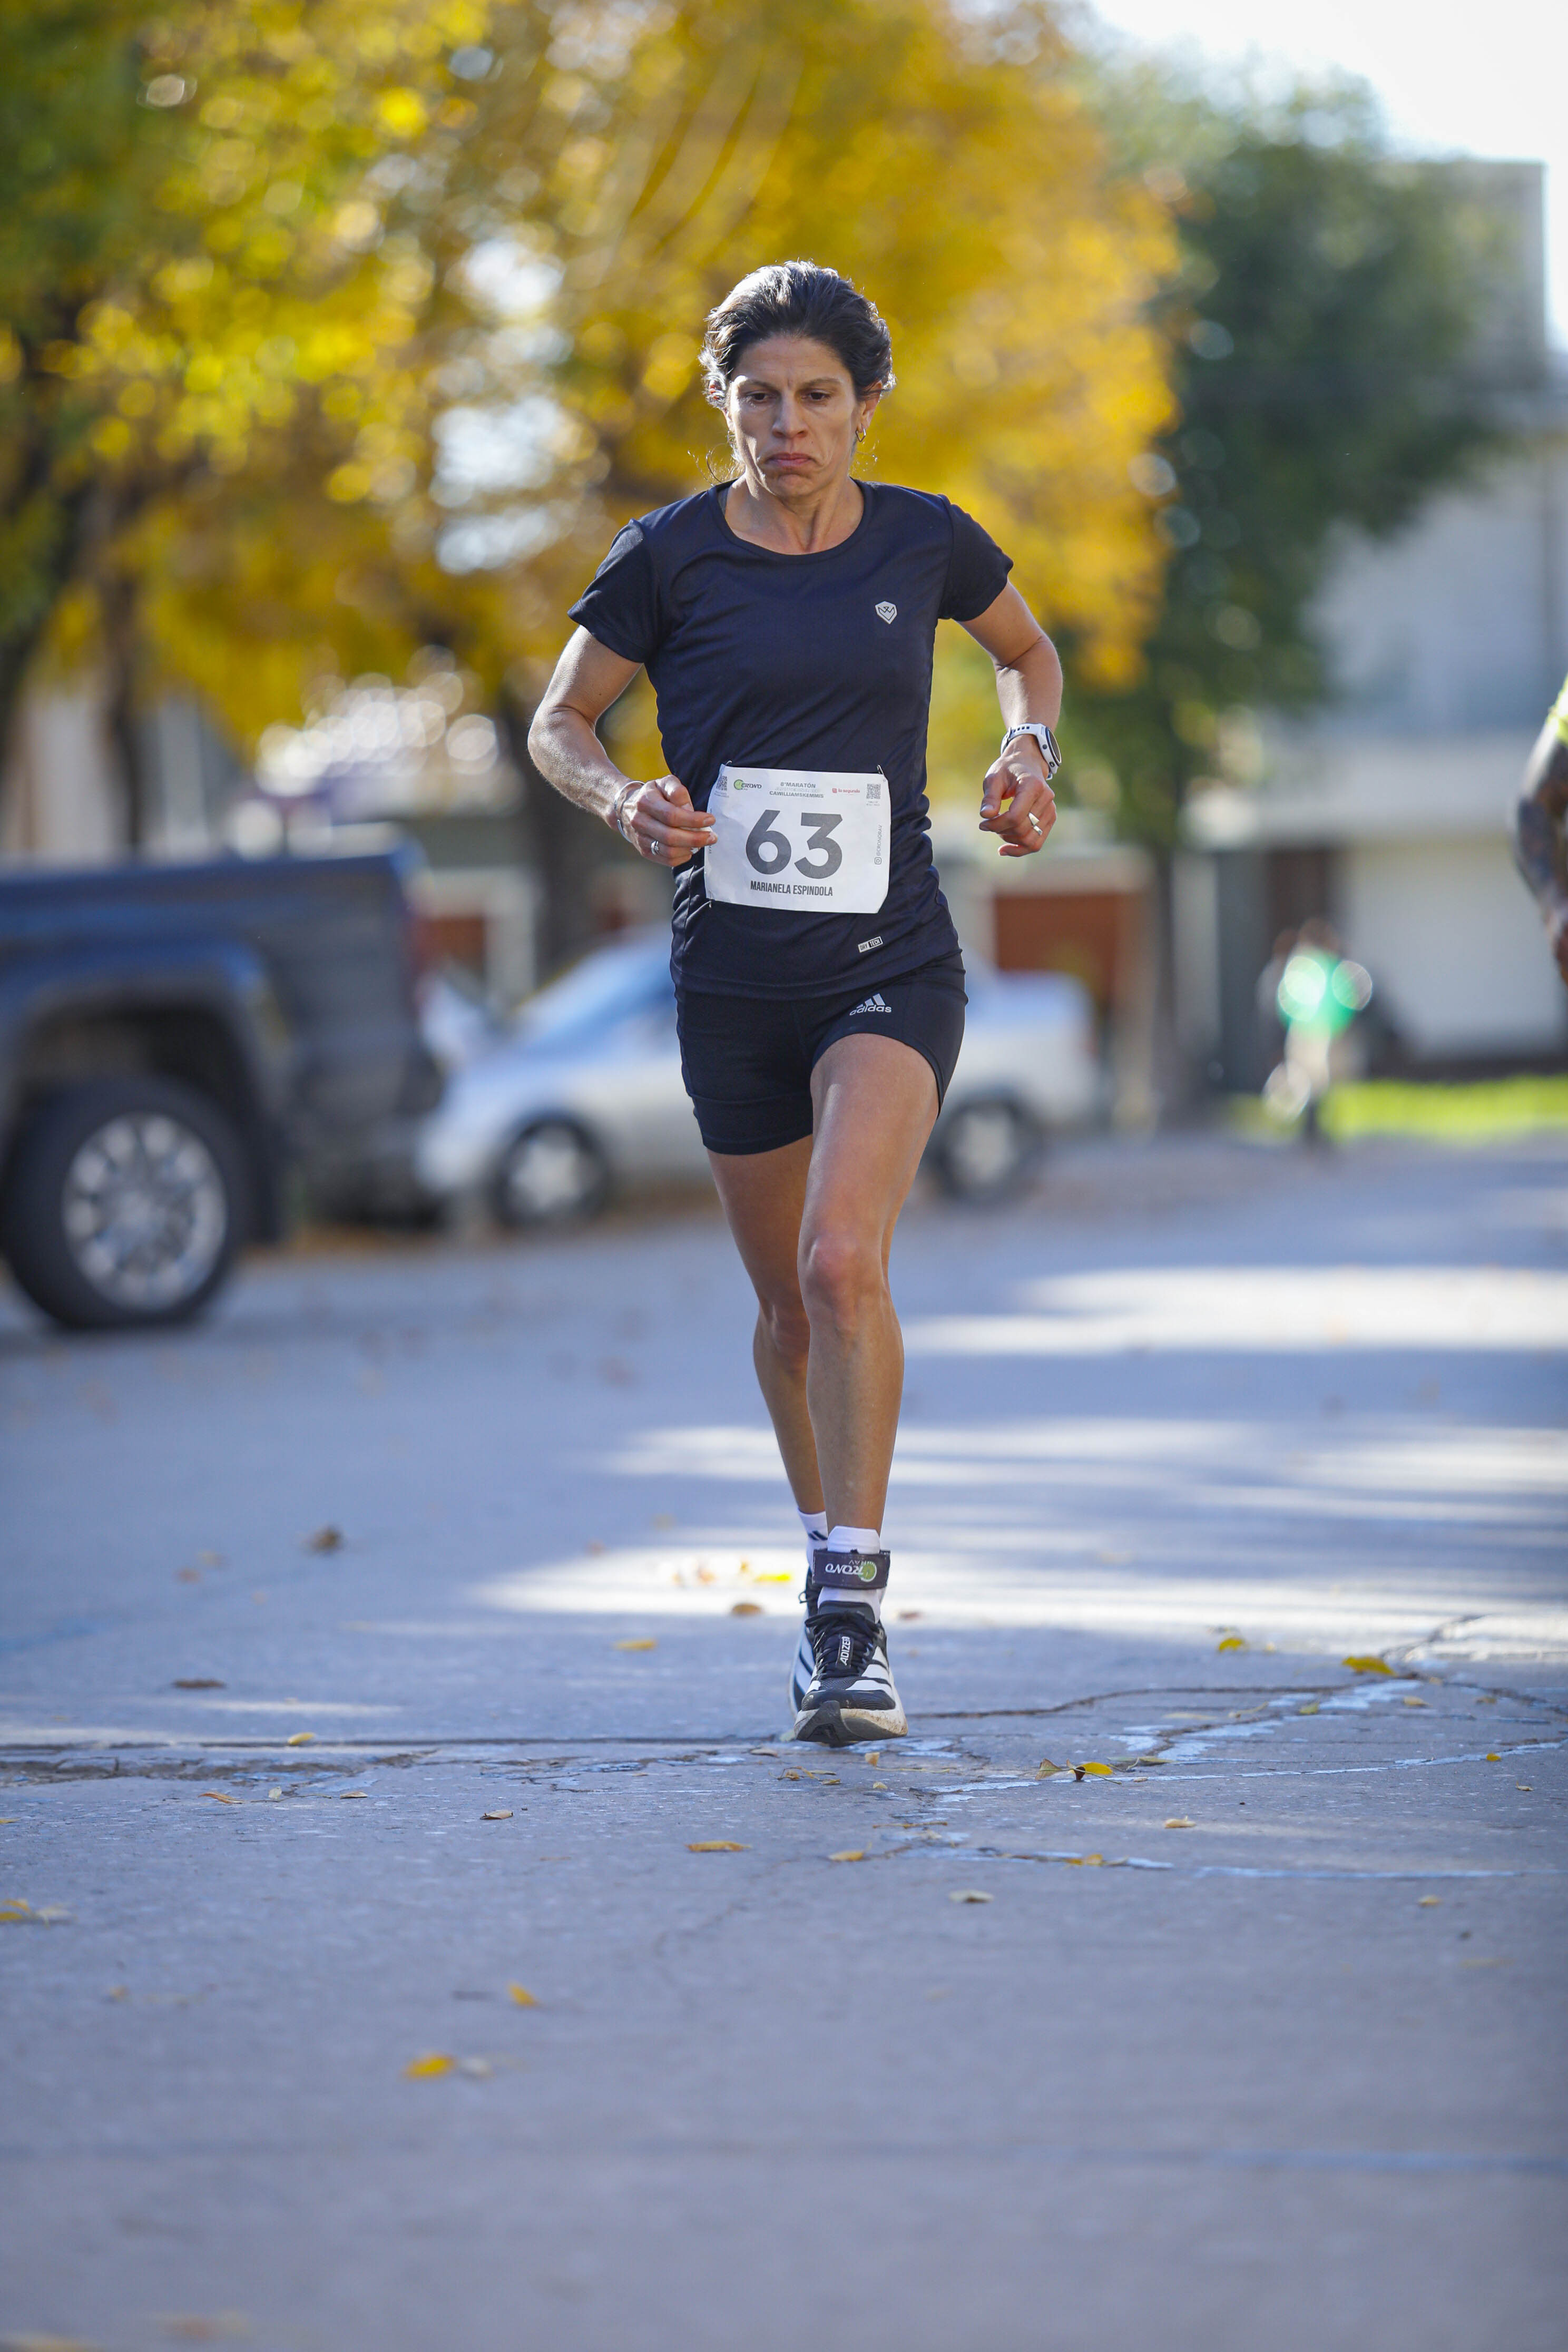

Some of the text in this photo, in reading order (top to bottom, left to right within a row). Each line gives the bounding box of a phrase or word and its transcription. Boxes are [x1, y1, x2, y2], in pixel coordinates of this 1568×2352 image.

[746, 809, 843, 879] 63
[750, 880, 833, 896] MARIANELA ESPINDOLA
[869, 938, 880, 947] TECH
[849, 1004, 891, 1016] adidas
